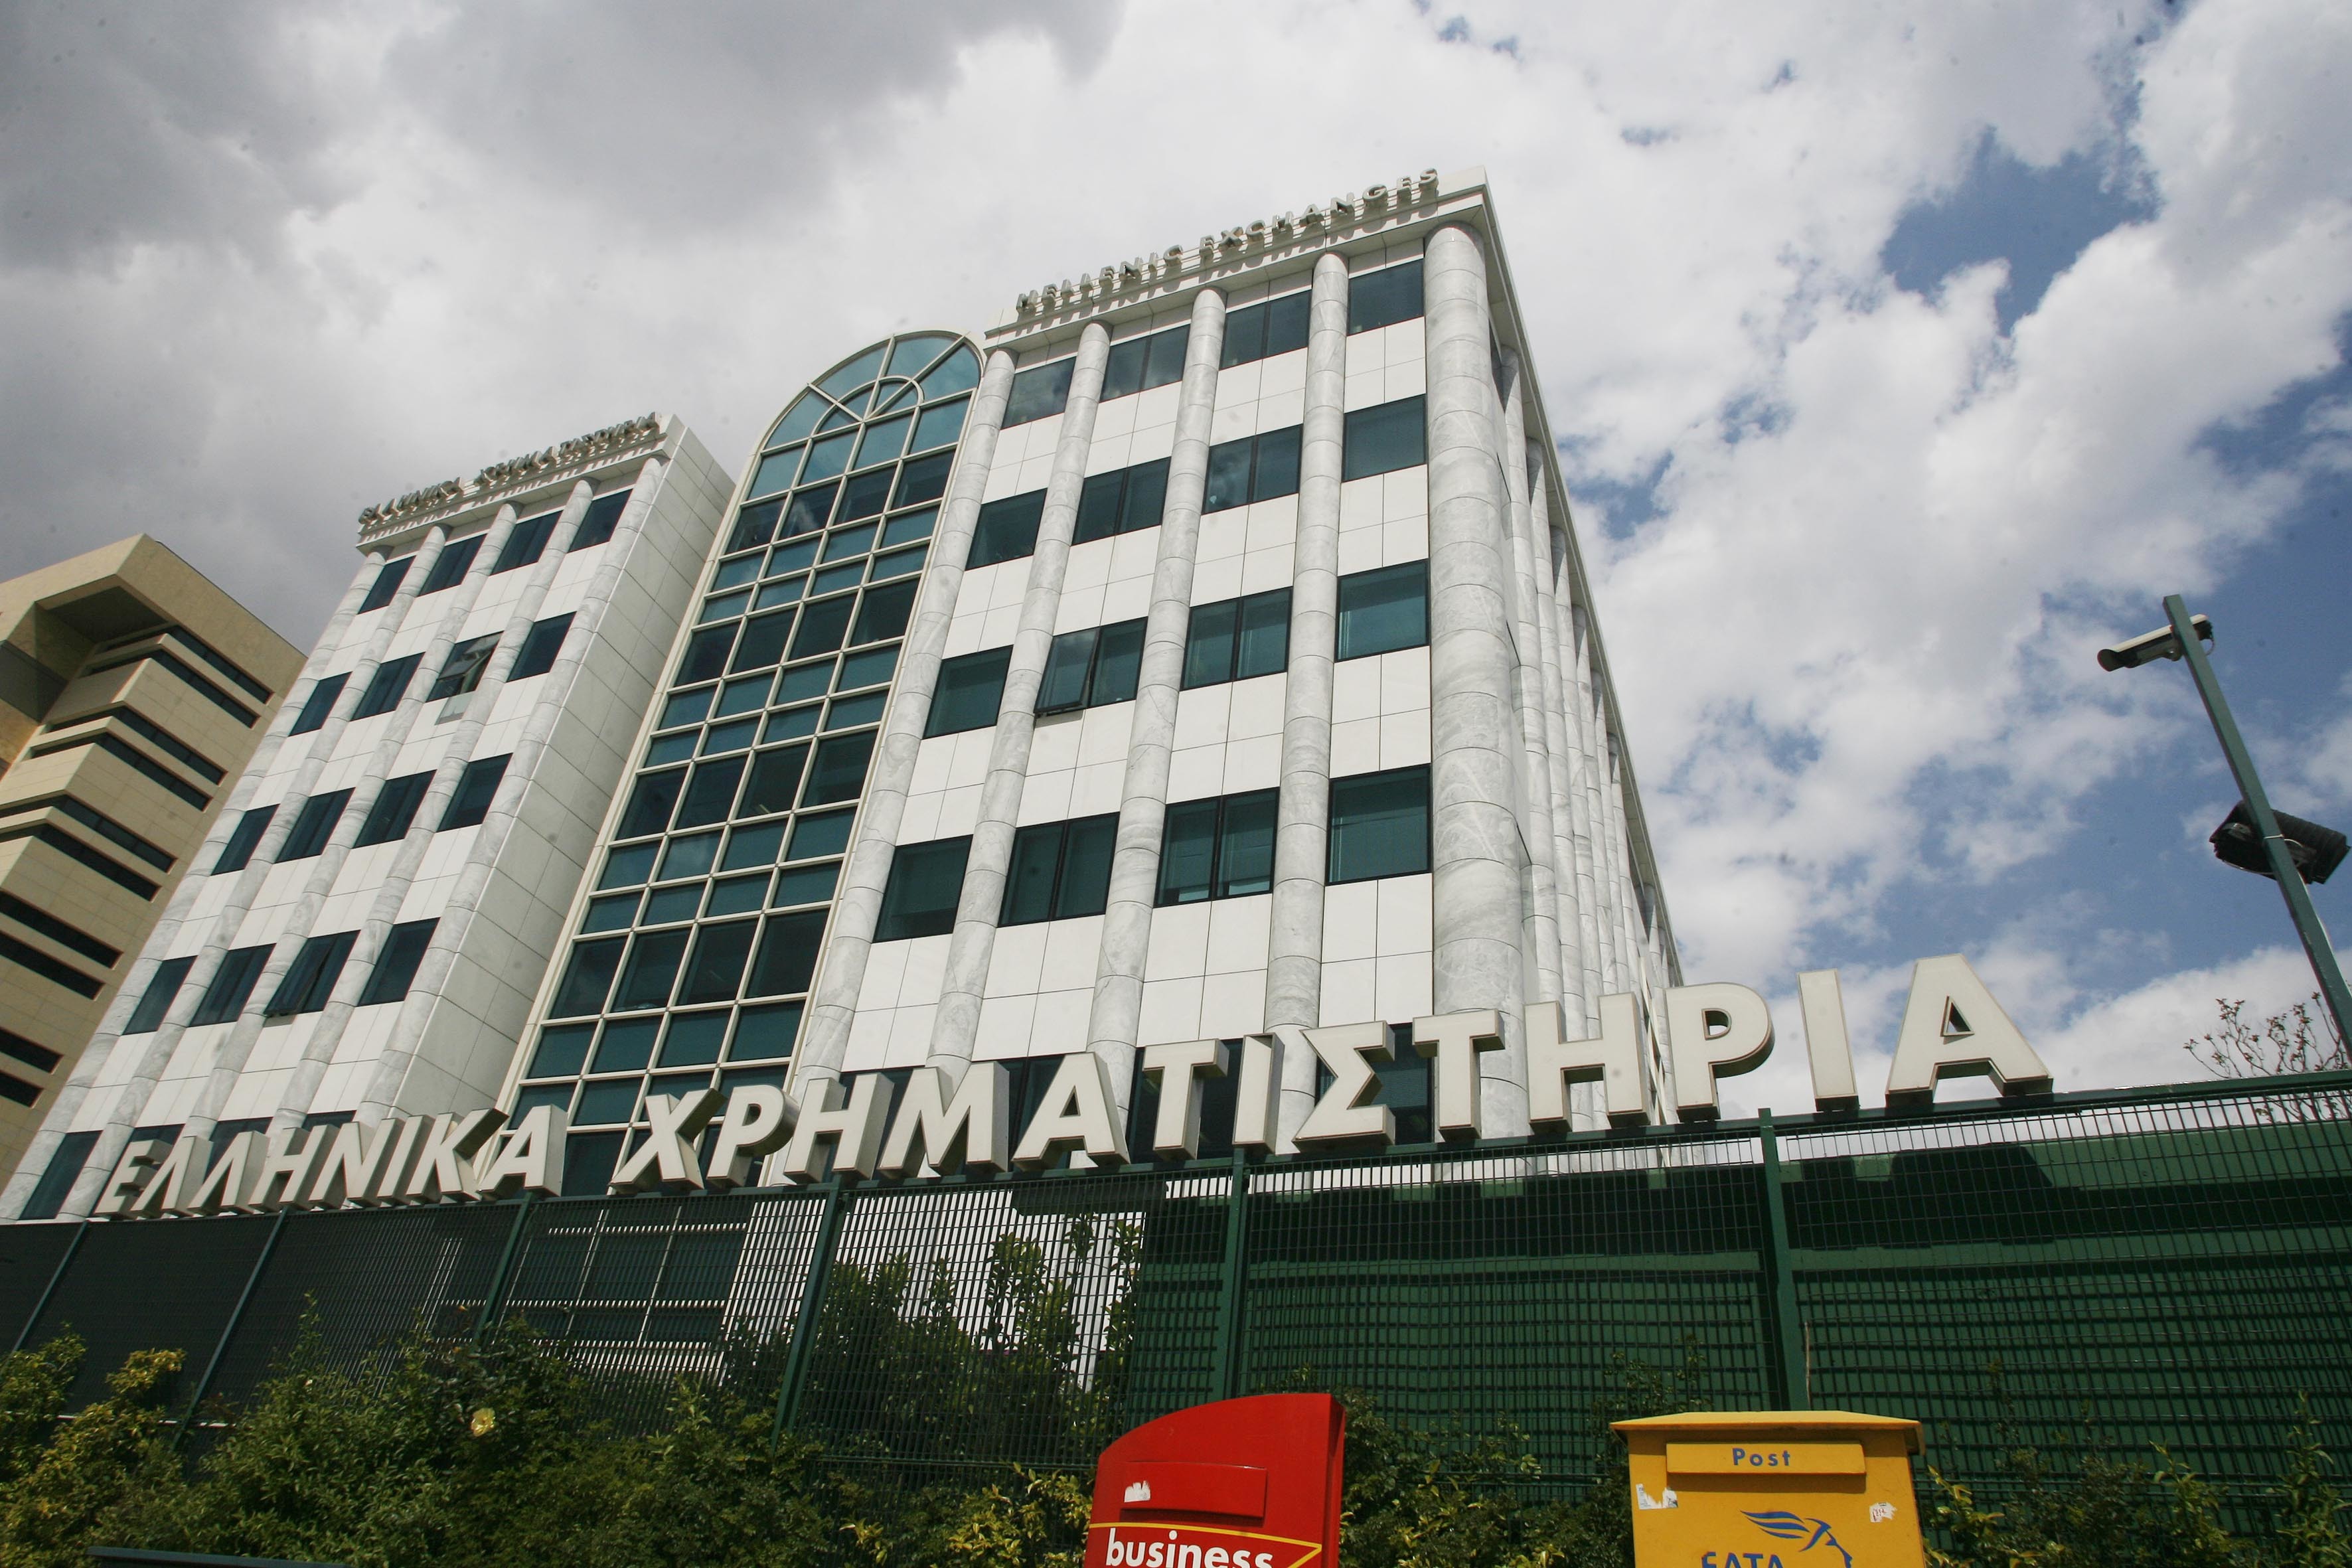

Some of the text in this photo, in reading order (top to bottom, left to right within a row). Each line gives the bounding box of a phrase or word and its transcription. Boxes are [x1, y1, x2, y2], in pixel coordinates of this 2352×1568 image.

[1016, 168, 1439, 313] HELLENIC EXCHANGES
[95, 953, 2054, 1219] ΕΛΛΗΝΙΚΑ ΧΡΗΜΑΤΙΣΤΗΡΙΑ
[1732, 1447, 1790, 1466] Post
[1105, 1528, 1273, 1568] business
